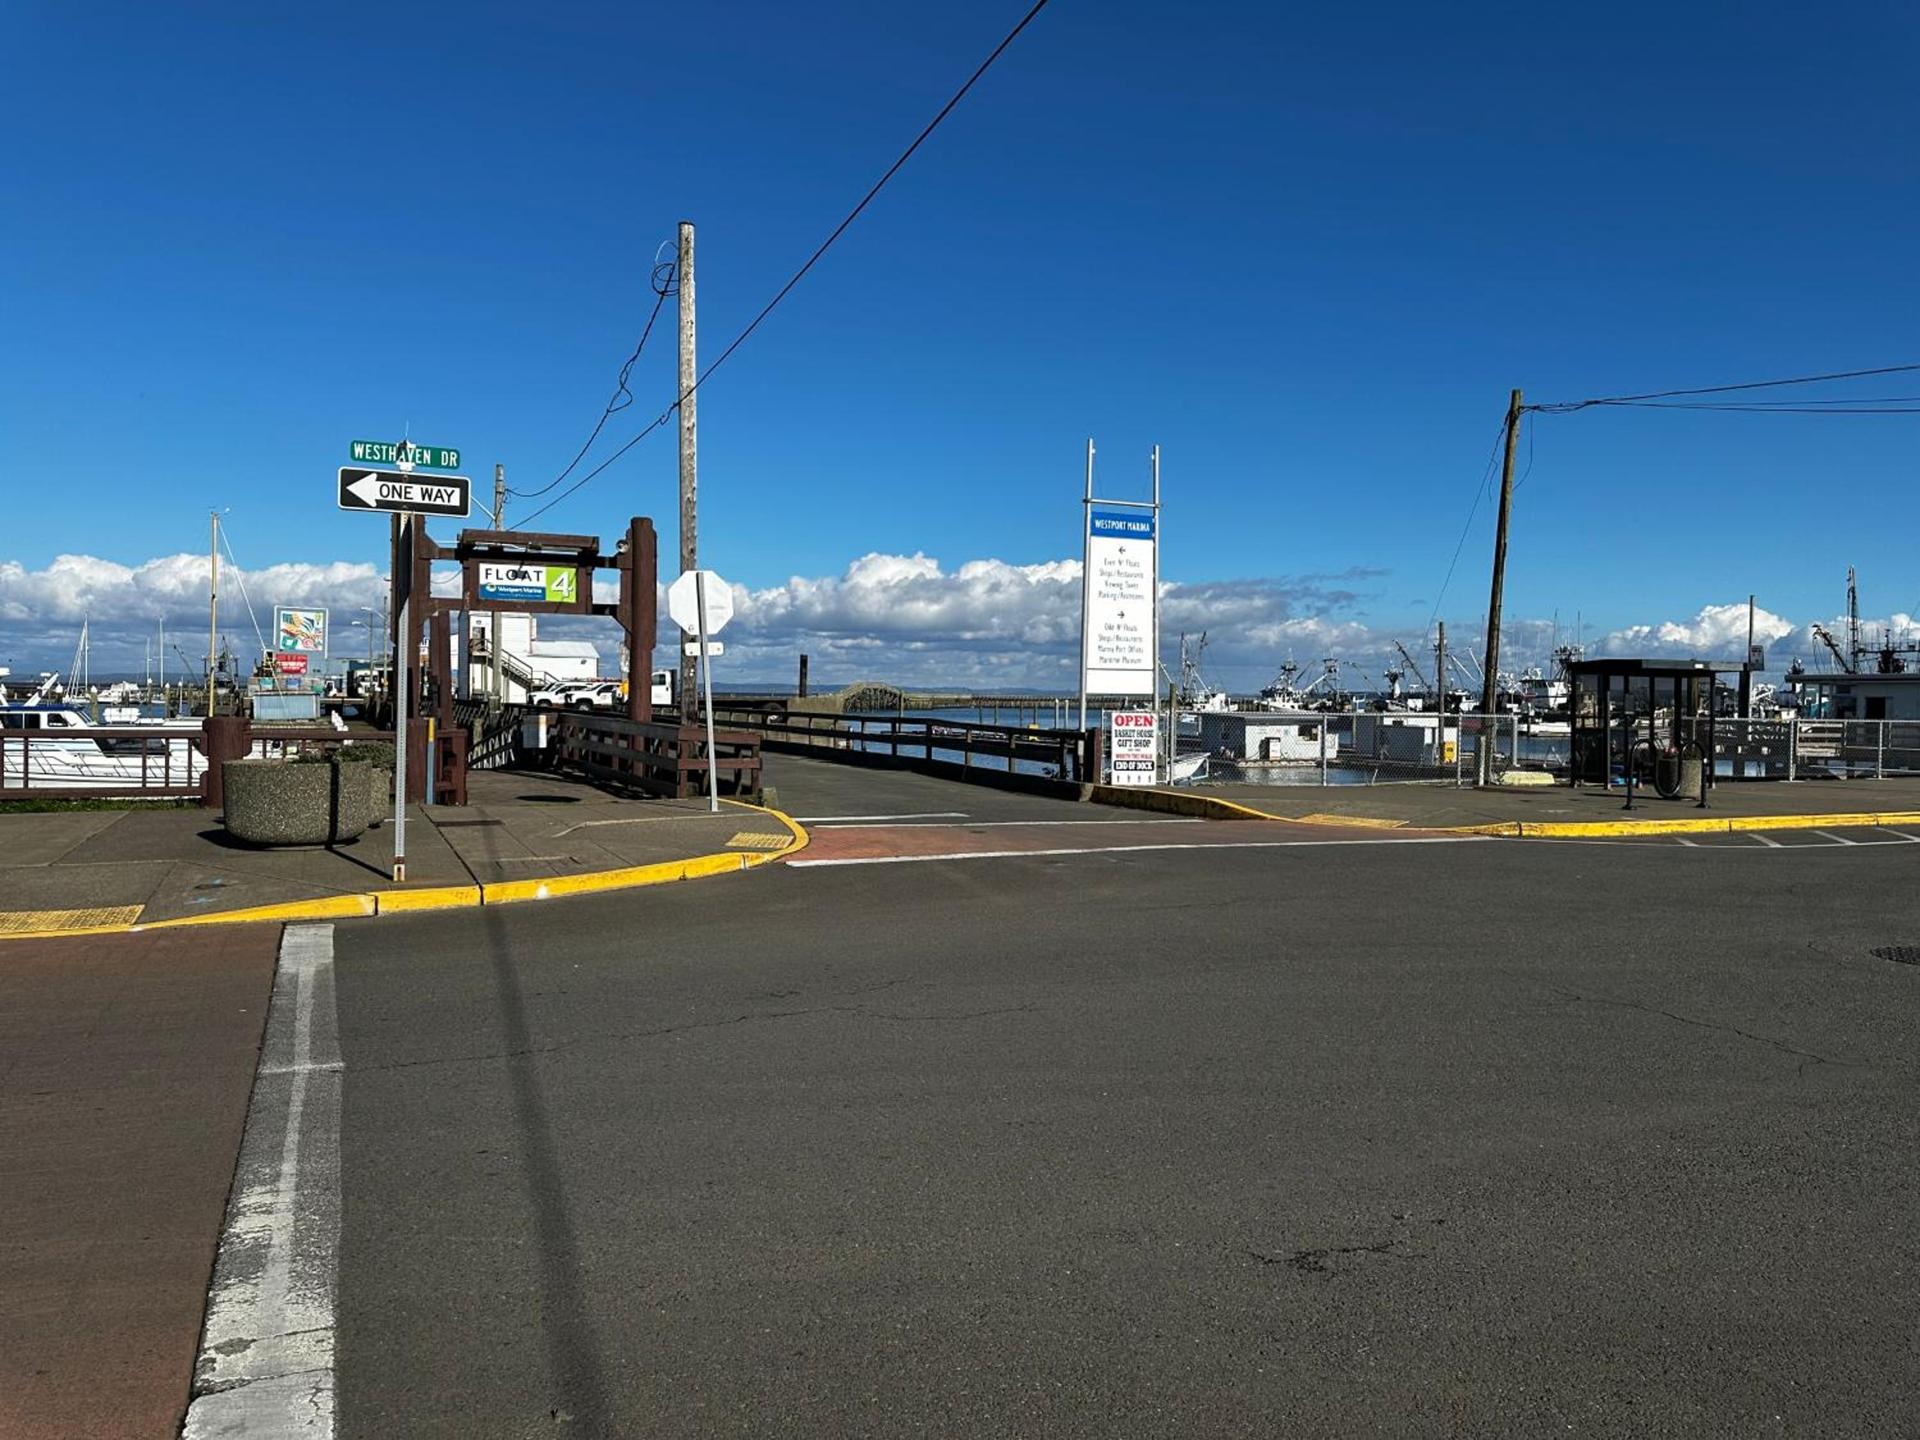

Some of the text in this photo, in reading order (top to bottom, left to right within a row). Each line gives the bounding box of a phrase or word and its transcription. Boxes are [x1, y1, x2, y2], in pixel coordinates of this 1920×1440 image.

[354, 442, 458, 466] WESTHAVEN DR
[380, 484, 455, 503] ONE WAY
[1094, 519, 1126, 530] WESTPORT
[485, 568, 571, 598] FLOAT 4
[1114, 715, 1154, 727] OPEN
[1117, 739, 1151, 748] GIFT SHOP
